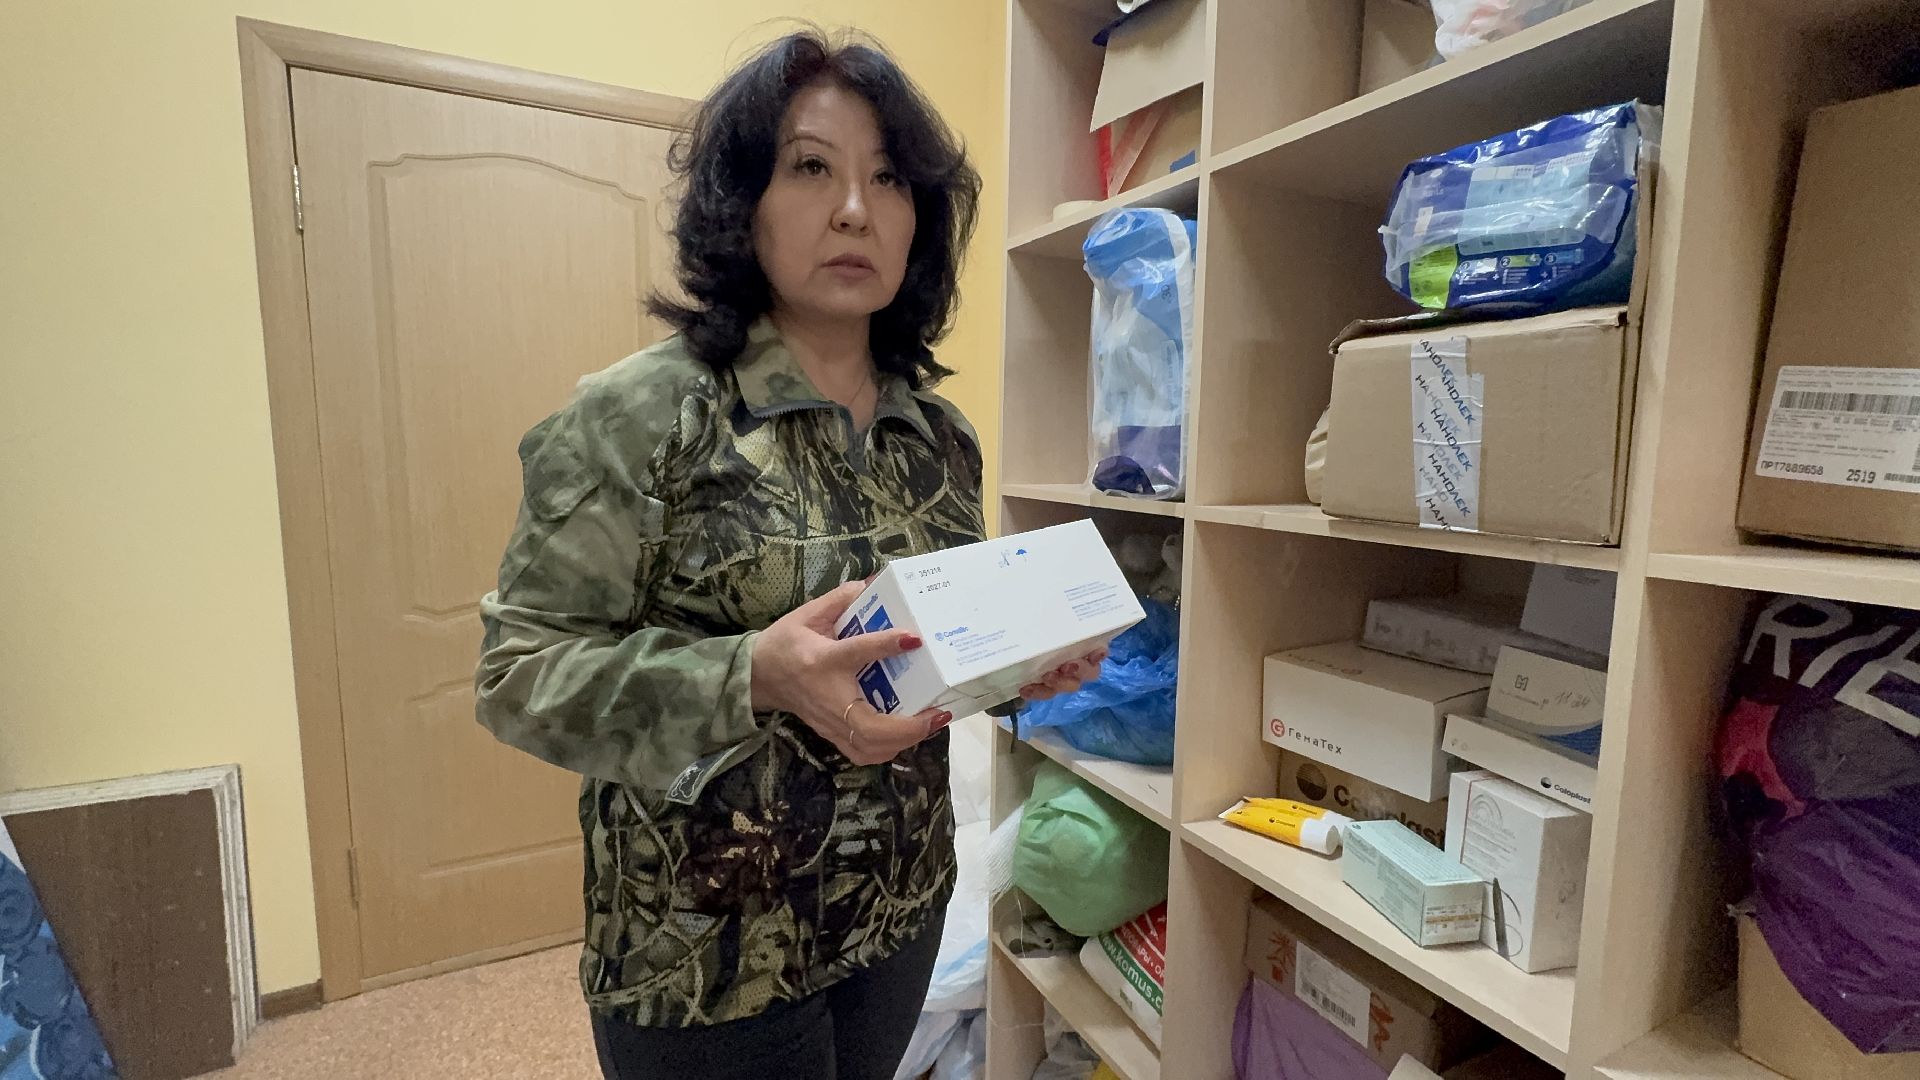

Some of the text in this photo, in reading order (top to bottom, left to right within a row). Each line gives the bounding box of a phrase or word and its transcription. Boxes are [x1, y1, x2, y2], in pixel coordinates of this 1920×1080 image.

[1430, 408, 1473, 472] НАНОЛЕК
[1428, 453, 1471, 518] НАНОЛЕК
[1846, 468, 1877, 484] 2519
[1288, 726, 1342, 755] ГемаТех
